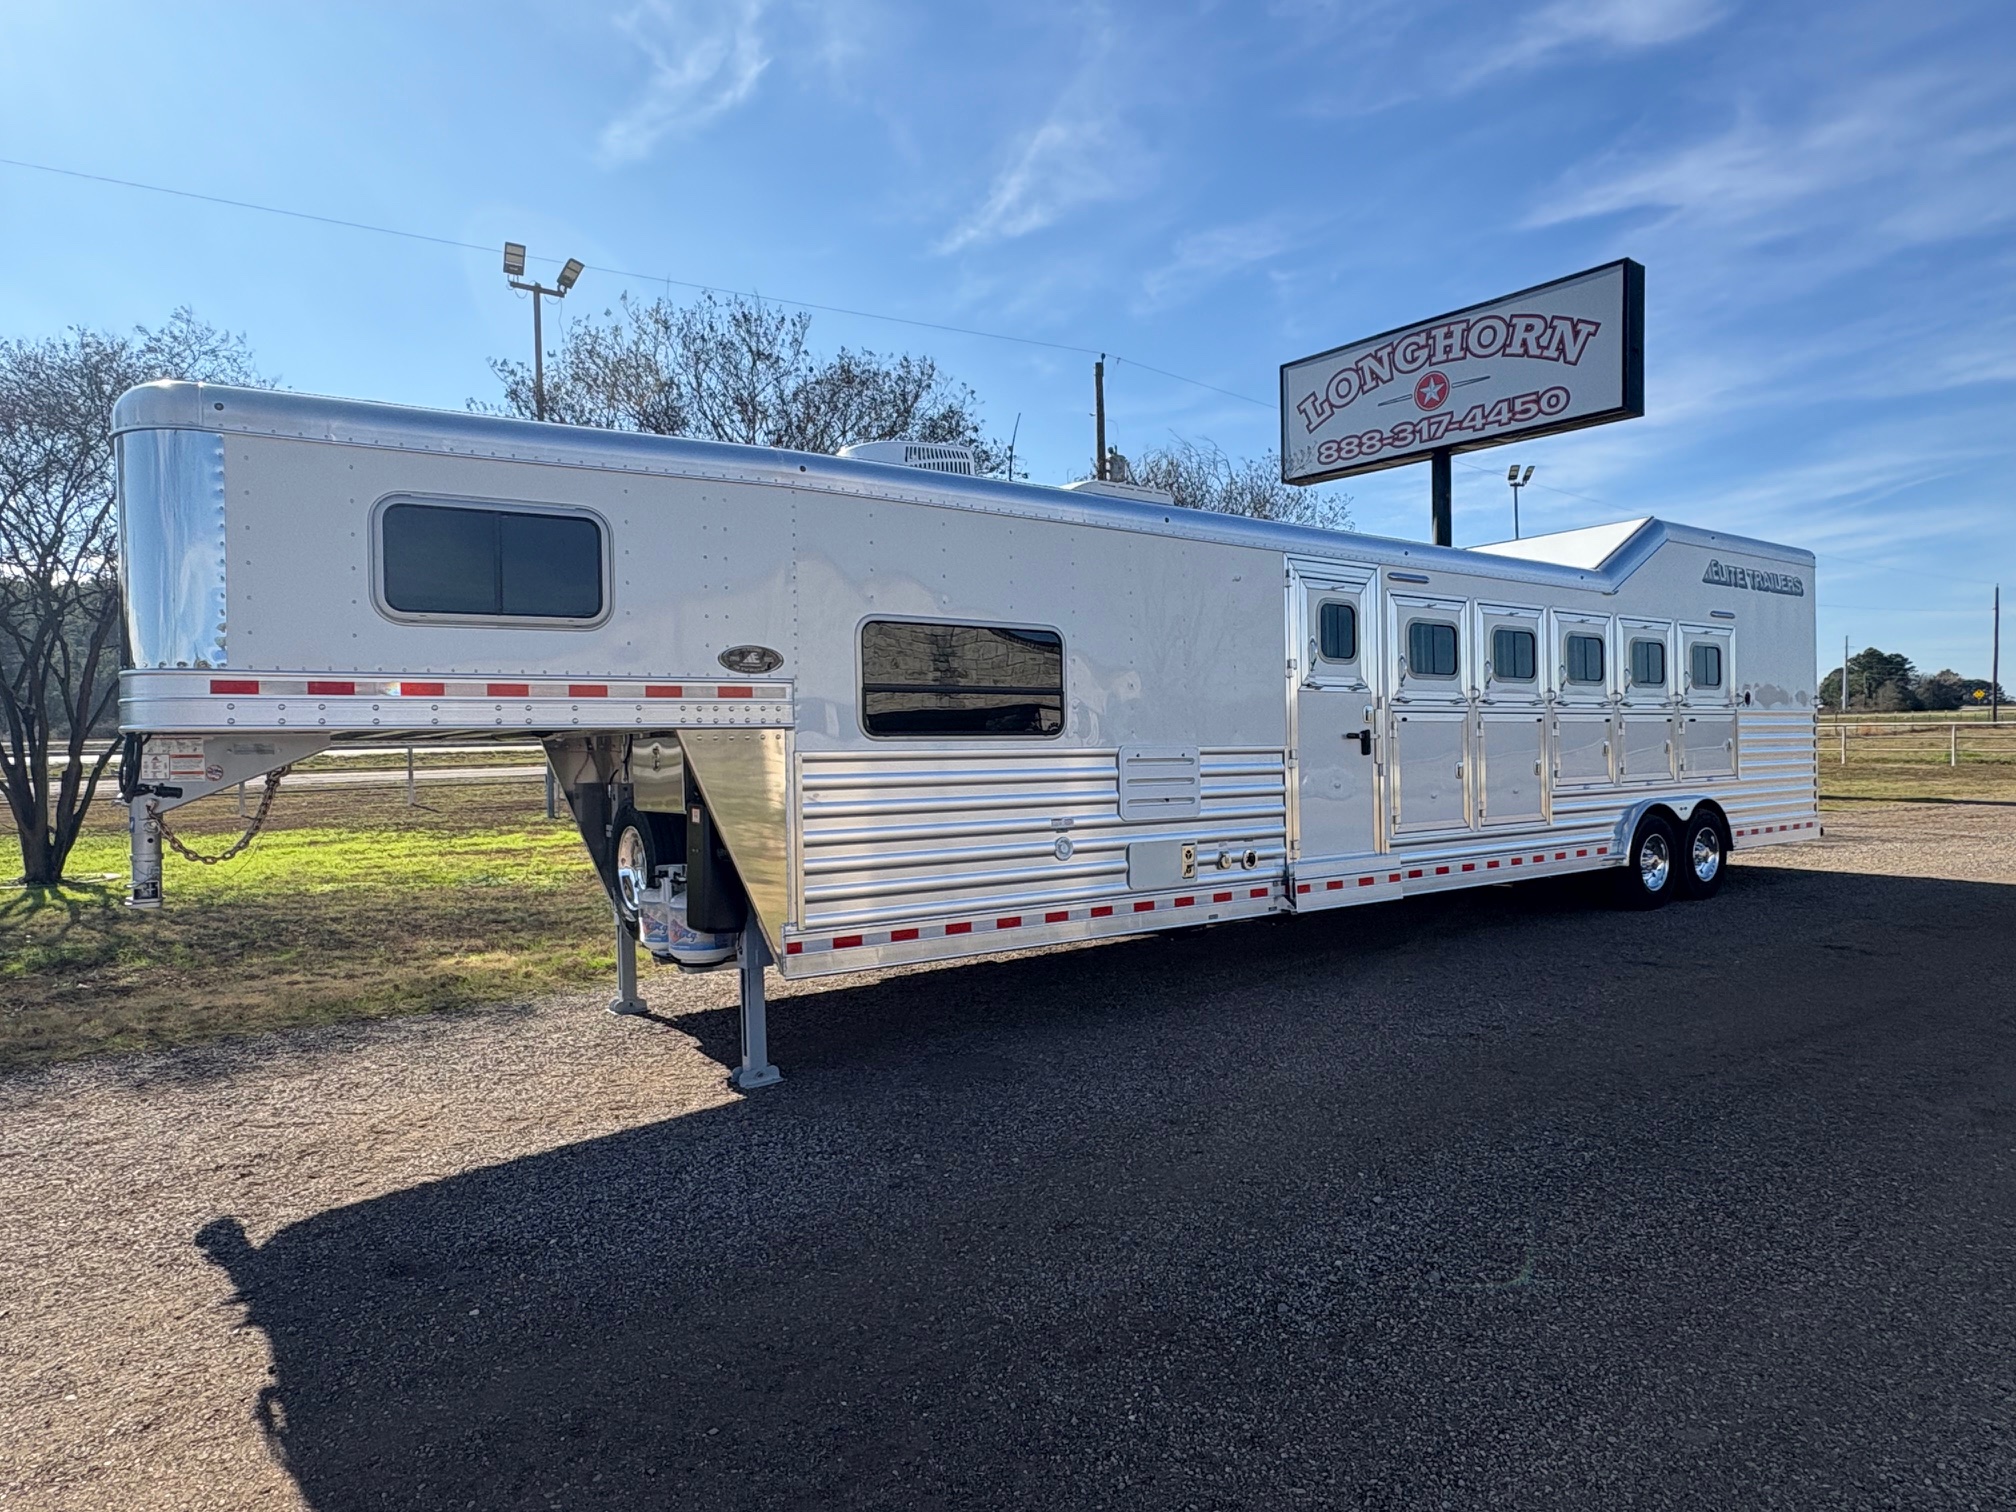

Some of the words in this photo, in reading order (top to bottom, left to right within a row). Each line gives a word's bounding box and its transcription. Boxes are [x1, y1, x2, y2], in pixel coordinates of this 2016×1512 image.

[1299, 314, 1601, 433] LONGHORN
[1318, 386, 1570, 465] 888-317-4450
[1702, 559, 1747, 589] ELITE
[1746, 569, 1804, 597] TRAILERS
